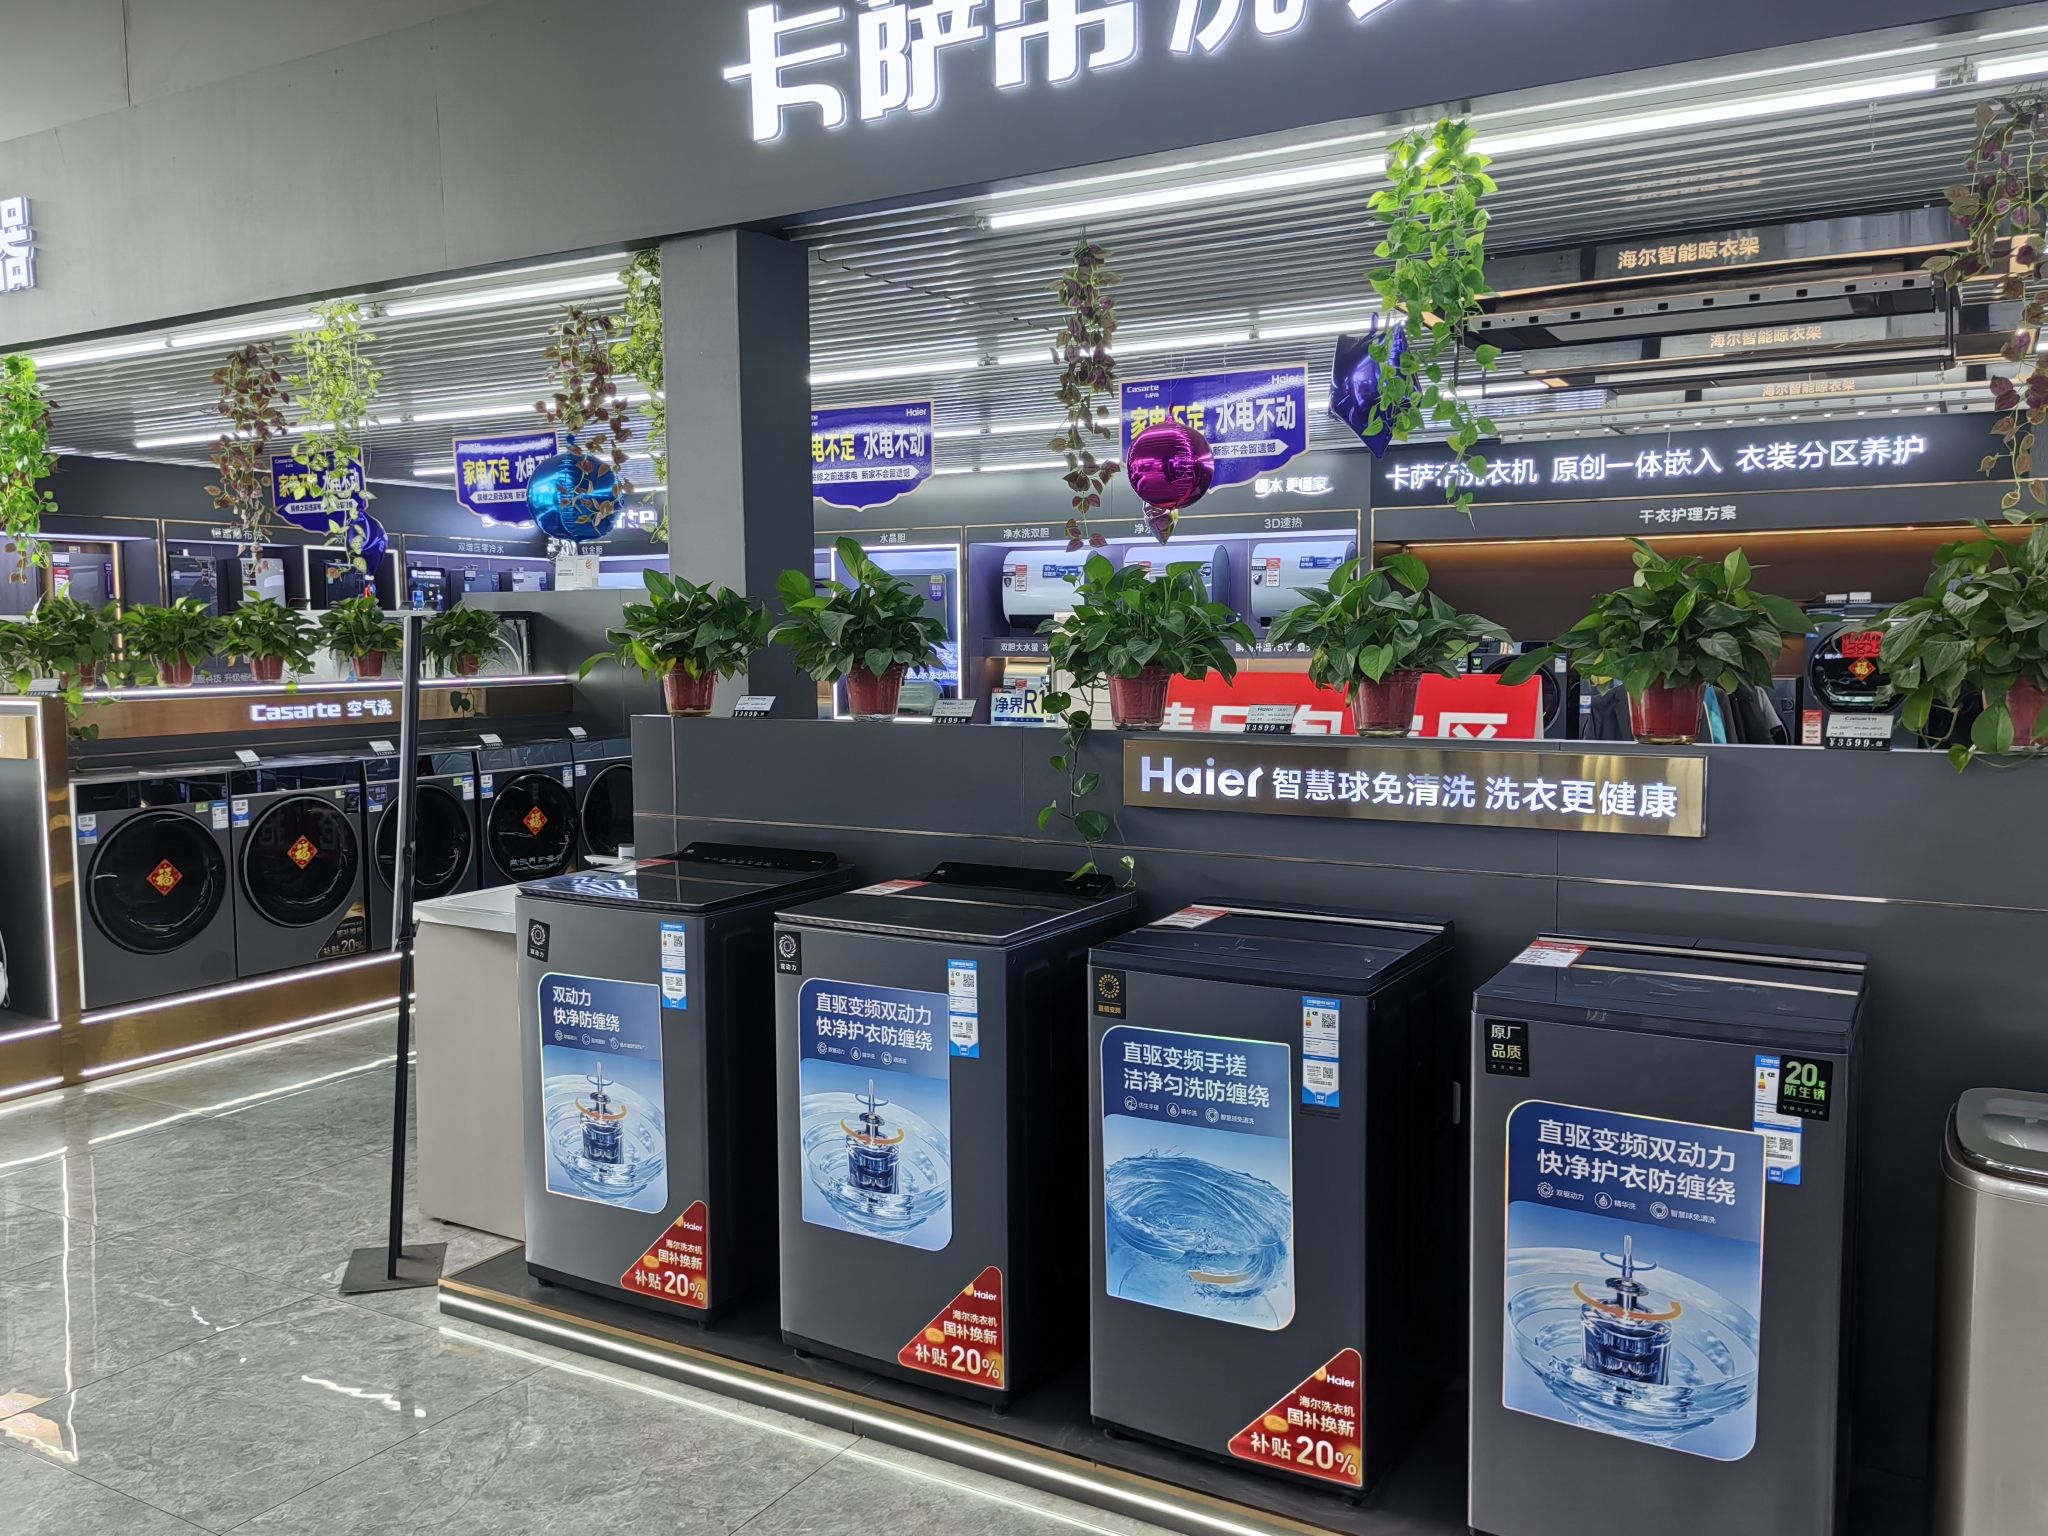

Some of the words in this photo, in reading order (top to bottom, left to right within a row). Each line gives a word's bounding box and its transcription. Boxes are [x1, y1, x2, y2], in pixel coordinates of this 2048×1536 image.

[1618, 236, 1760, 270] 海尔智能晾衣架
[1710, 325, 1822, 348] 海尔智能晾衣架
[1127, 384, 1159, 393] Casarte
[1272, 374, 1301, 385] Haier
[906, 408, 927, 416] Haier
[1216, 395, 1296, 435] 水电不动
[863, 427, 925, 460] 水电不动
[463, 458, 511, 487] 家电不定
[515, 452, 552, 482] 水电
[1552, 448, 1723, 483] 原创一体嵌入
[1736, 435, 1926, 473] 衣装分区养护
[1264, 515, 1303, 529] 3D速热
[1639, 505, 1737, 524] 干衣护理方案
[879, 533, 906, 543] 水晶胆
[1003, 528, 1050, 539] 净水洗双胆
[1000, 642, 1039, 652] 双胆大水量
[251, 703, 342, 722] Casarte
[347, 699, 393, 717] 空气洗
[1141, 756, 1264, 797] Haier
[1272, 766, 1477, 808] 智慧球免清洗
[1484, 776, 1678, 819] 洗衣更健康
[294, 842, 309, 861] 福
[154, 866, 173, 887] 福
[552, 985, 591, 1007] 双动力
[553, 1006, 620, 1033] 快净防缠绕
[816, 992, 932, 1026] 直驱变频双动力
[816, 1016, 933, 1052] 快净护衣防缠绕
[1491, 1024, 1521, 1040] 原厂
[1123, 1041, 1248, 1078] 直驱变频手搓
[1491, 1043, 1522, 1060] 品质
[1123, 1068, 1270, 1109] 洁净匀洗防缠绕
[1537, 1118, 1736, 1173] 直驱变频双动力
[1536, 1148, 1736, 1206] 快净护衣防缠绕
[1555, 1188, 1585, 1201] 双驱动力
[1613, 1199, 1637, 1211] 精华洗
[1670, 1209, 1717, 1225] 智慧球免清洗
[683, 1222, 703, 1232] Haier
[666, 1238, 703, 1256] 海尔洗衣机
[658, 1248, 703, 1271] 国补换新
[974, 1289, 997, 1301] Haier
[953, 1309, 998, 1328] 海尔洗衣机
[943, 1320, 998, 1346] 国补换新
[1327, 1374, 1355, 1389] Haier
[1300, 1395, 1355, 1418] 海尔洗衣机
[1287, 1407, 1355, 1438] 国补换新
